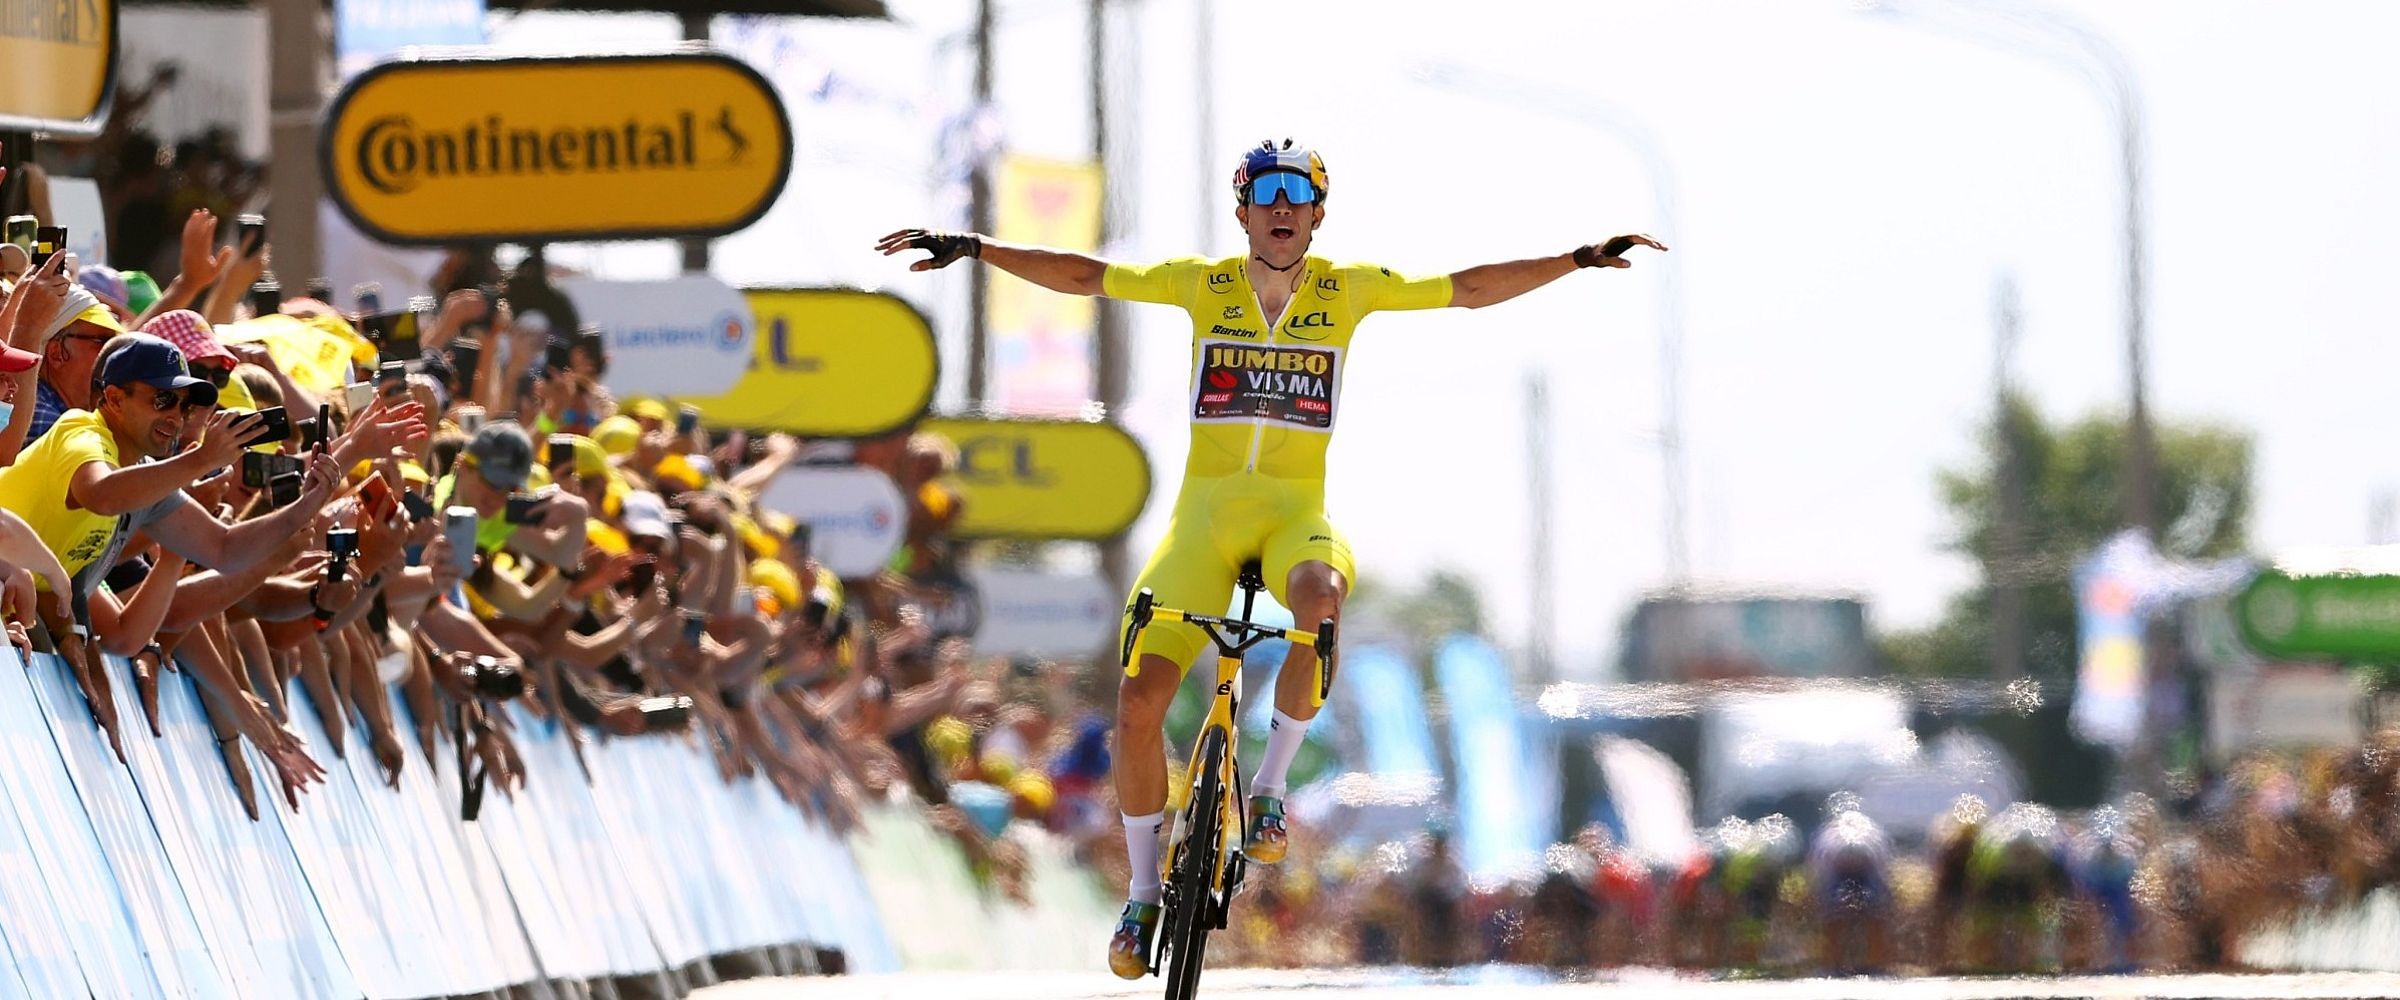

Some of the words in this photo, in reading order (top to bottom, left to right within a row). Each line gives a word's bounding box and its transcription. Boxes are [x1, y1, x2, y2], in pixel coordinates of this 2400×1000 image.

[357, 108, 698, 194] Continental
[1210, 273, 1234, 285] LCL
[1318, 278, 1340, 292] LCL
[1290, 312, 1334, 328] LCL
[1211, 325, 1257, 338] Santini
[1210, 348, 1328, 375] JUMBO
[1247, 370, 1325, 398] VISMA
[1300, 400, 1327, 411] HEMA
